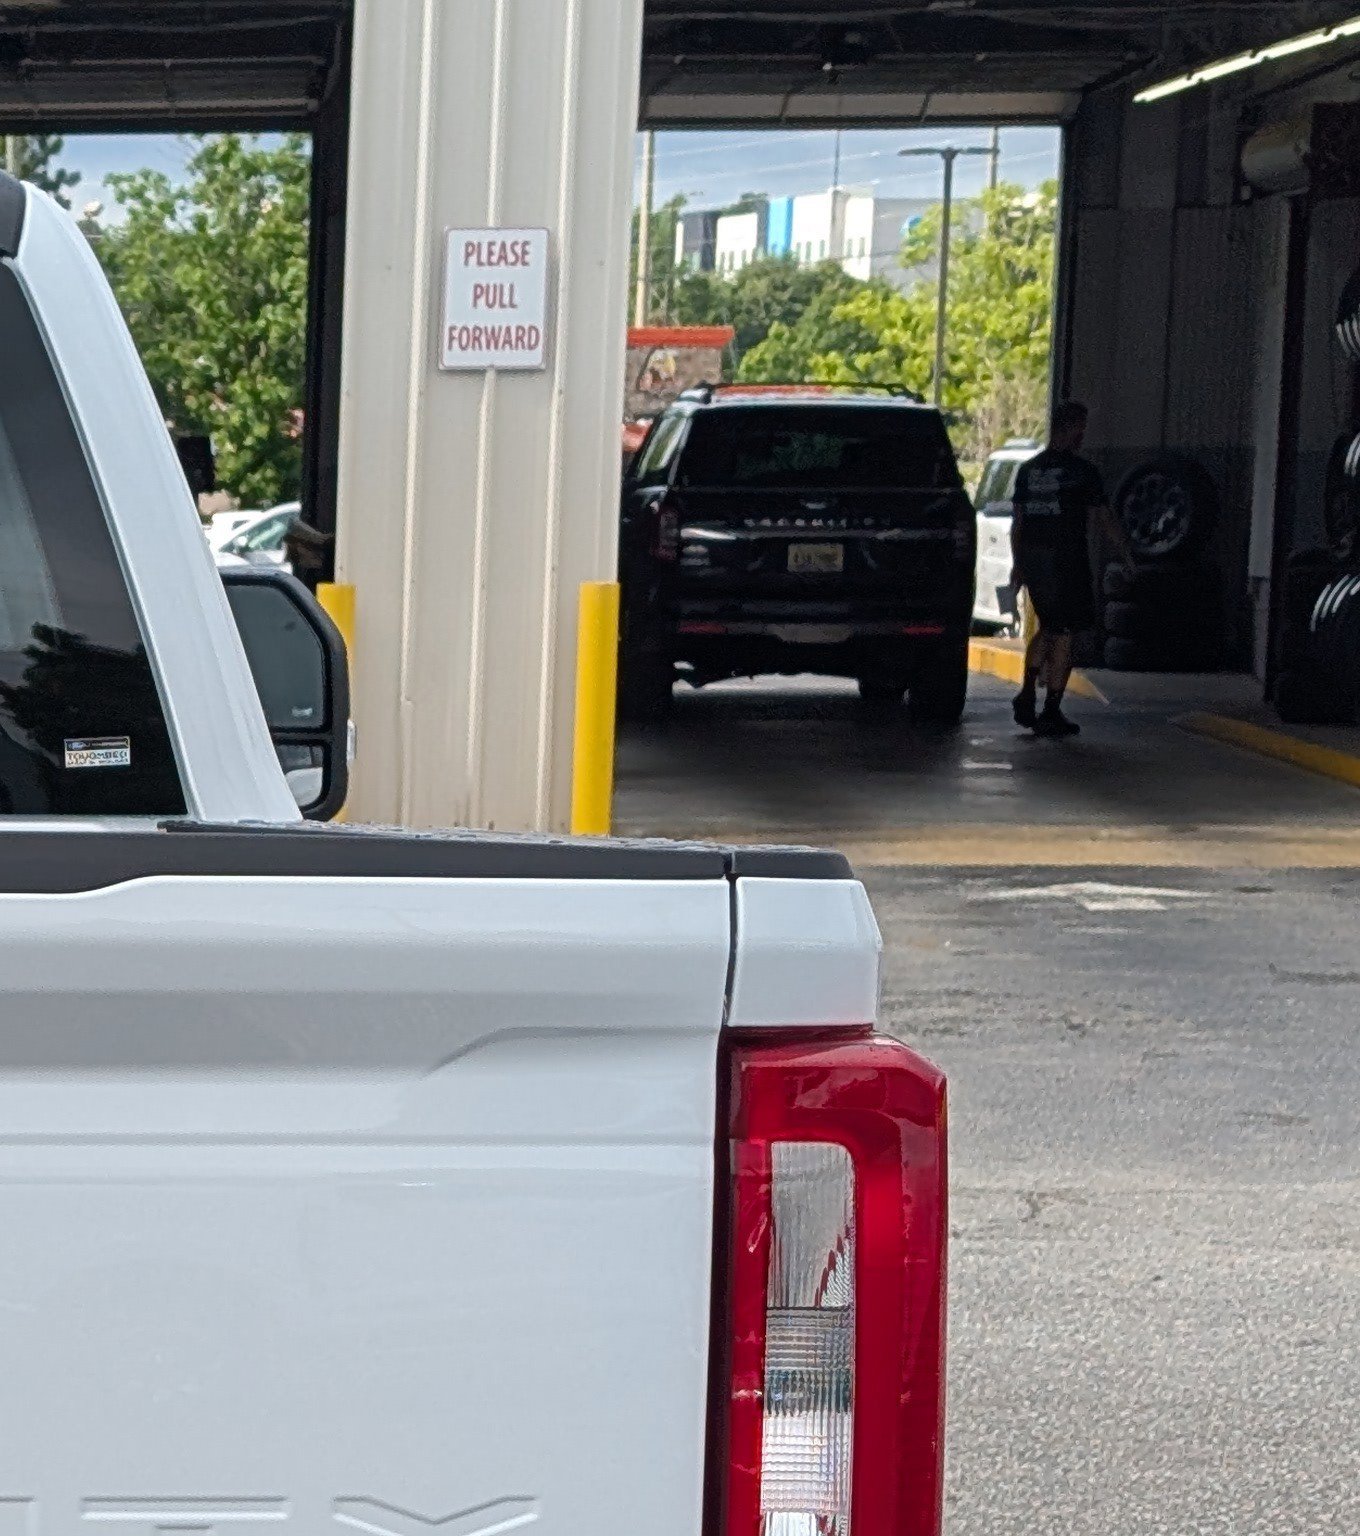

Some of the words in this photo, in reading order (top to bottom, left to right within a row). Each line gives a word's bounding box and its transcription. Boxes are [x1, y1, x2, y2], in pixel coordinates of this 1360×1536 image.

[464, 240, 531, 267] PLEASE
[472, 283, 518, 309] PULL
[447, 325, 540, 351] FORWARD
